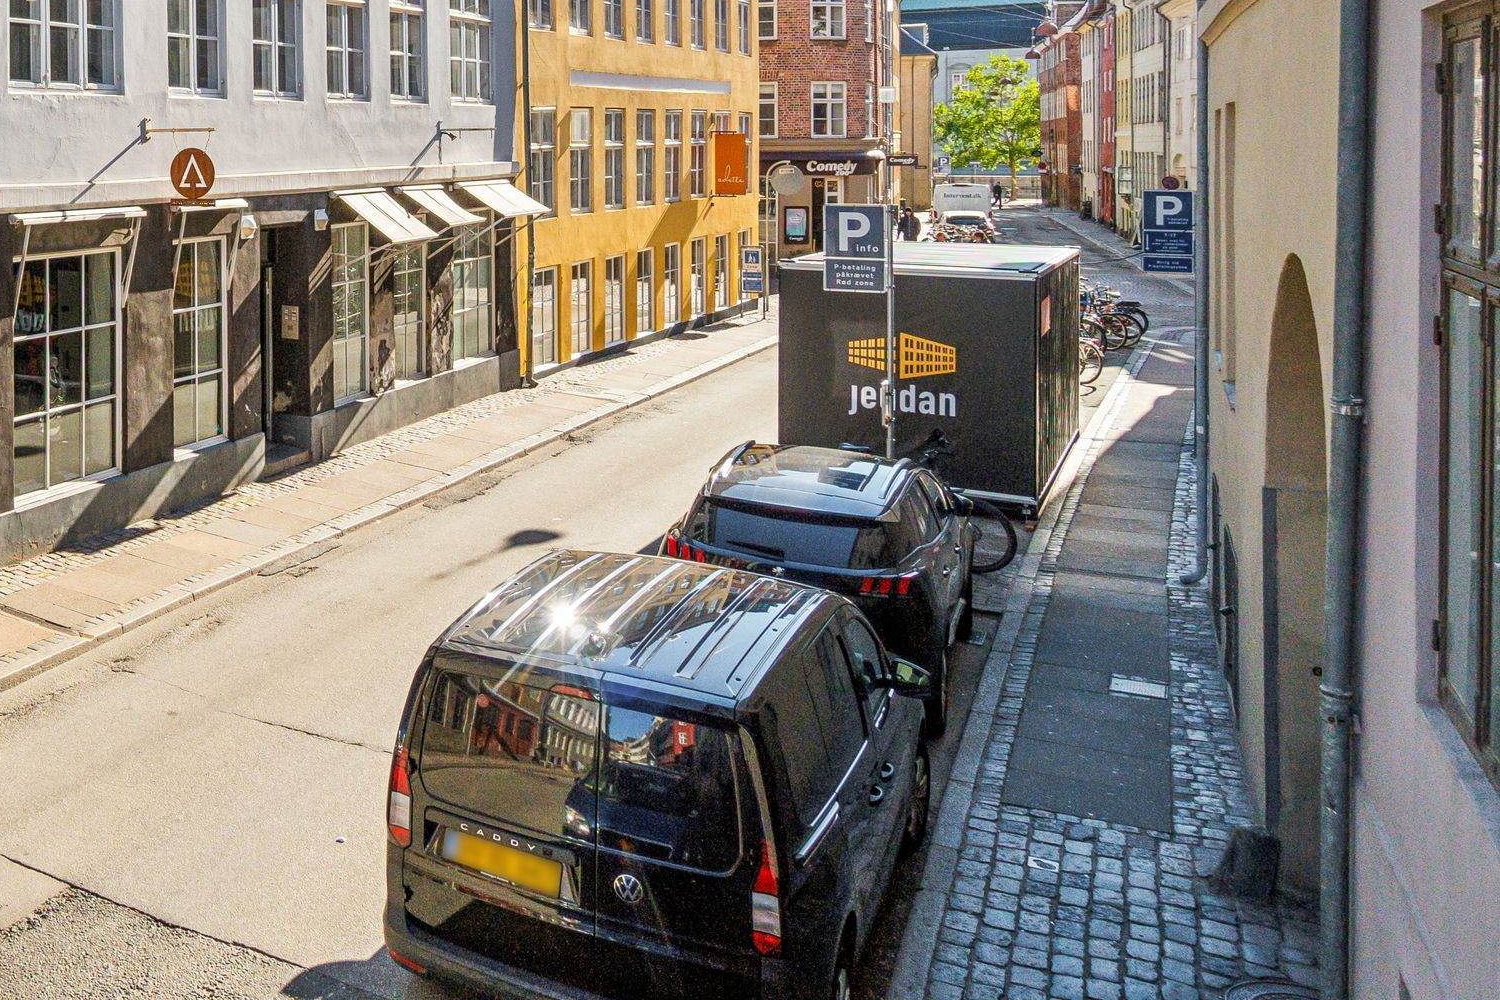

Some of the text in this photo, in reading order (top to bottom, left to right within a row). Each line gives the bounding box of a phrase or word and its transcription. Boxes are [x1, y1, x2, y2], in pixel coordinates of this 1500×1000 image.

[806, 160, 858, 174] Comedy
[939, 157, 948, 166] P
[1155, 195, 1183, 226] P
[838, 211, 879, 252] P info
[834, 263, 876, 272] P-betaling
[836, 271, 874, 279] påkrævet
[460, 823, 536, 851] CADDY
